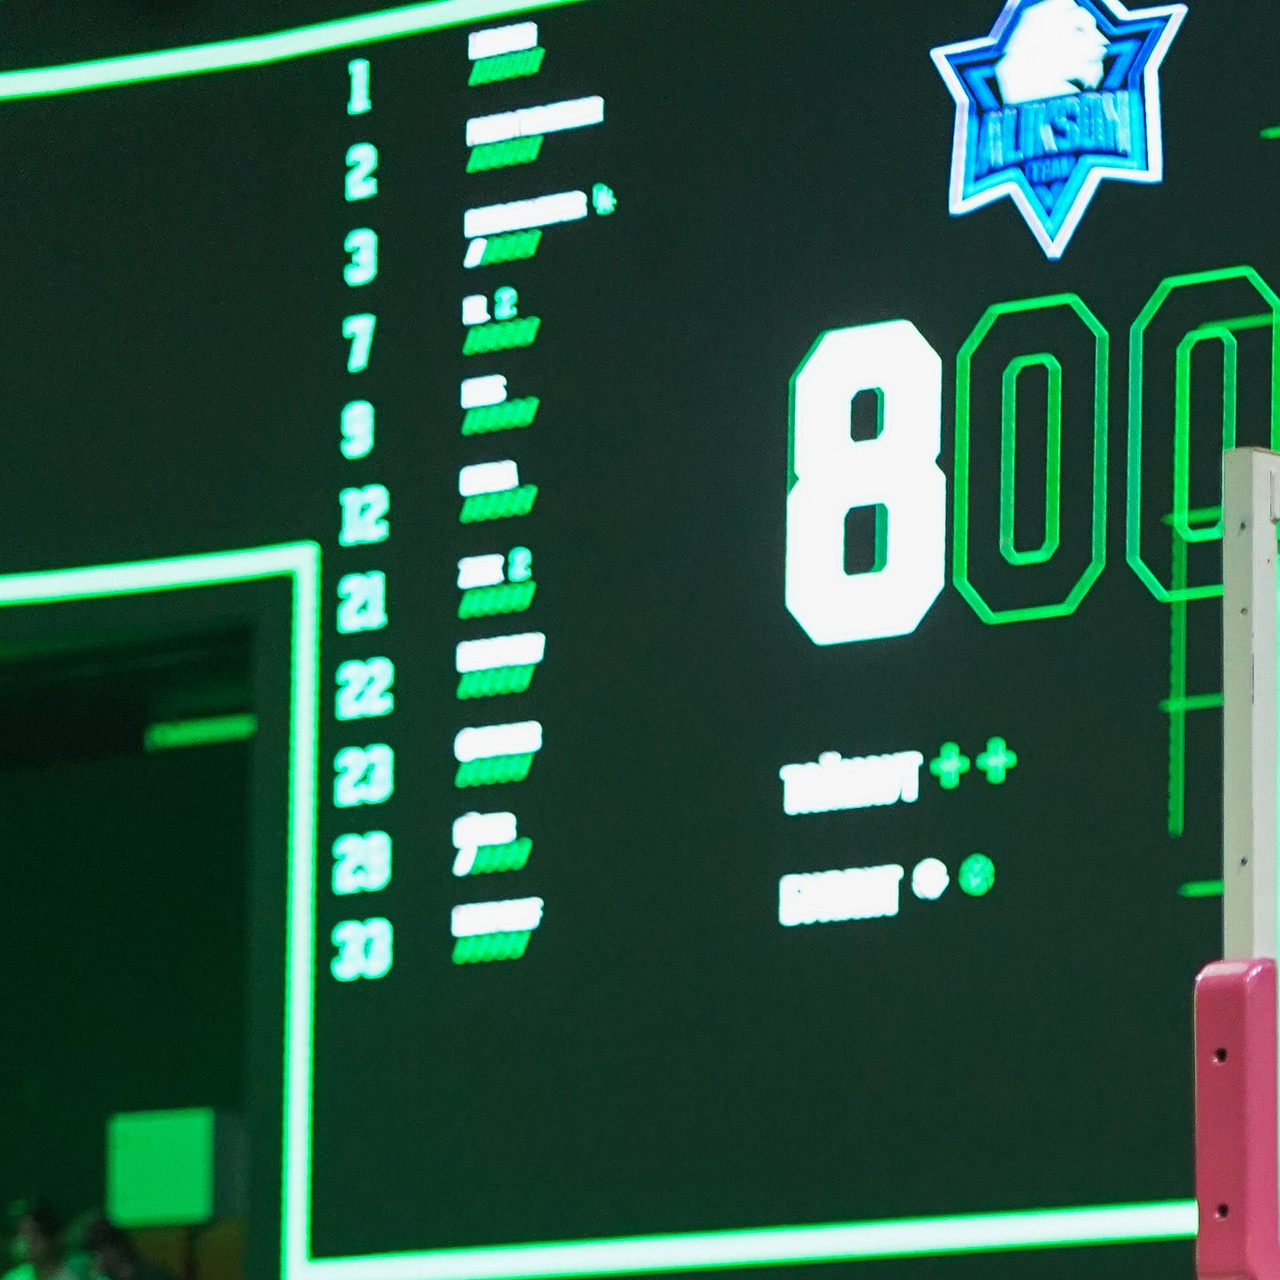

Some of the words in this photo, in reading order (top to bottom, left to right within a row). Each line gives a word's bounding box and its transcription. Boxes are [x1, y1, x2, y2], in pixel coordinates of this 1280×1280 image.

[347, 58, 372, 115] 1
[345, 142, 378, 201] 2
[343, 227, 378, 286] 3
[341, 313, 377, 373] 7
[340, 400, 375, 460] 9
[338, 483, 390, 546] 12
[336, 570, 388, 634] 21
[334, 656, 395, 721] 22
[333, 743, 395, 808] 23
